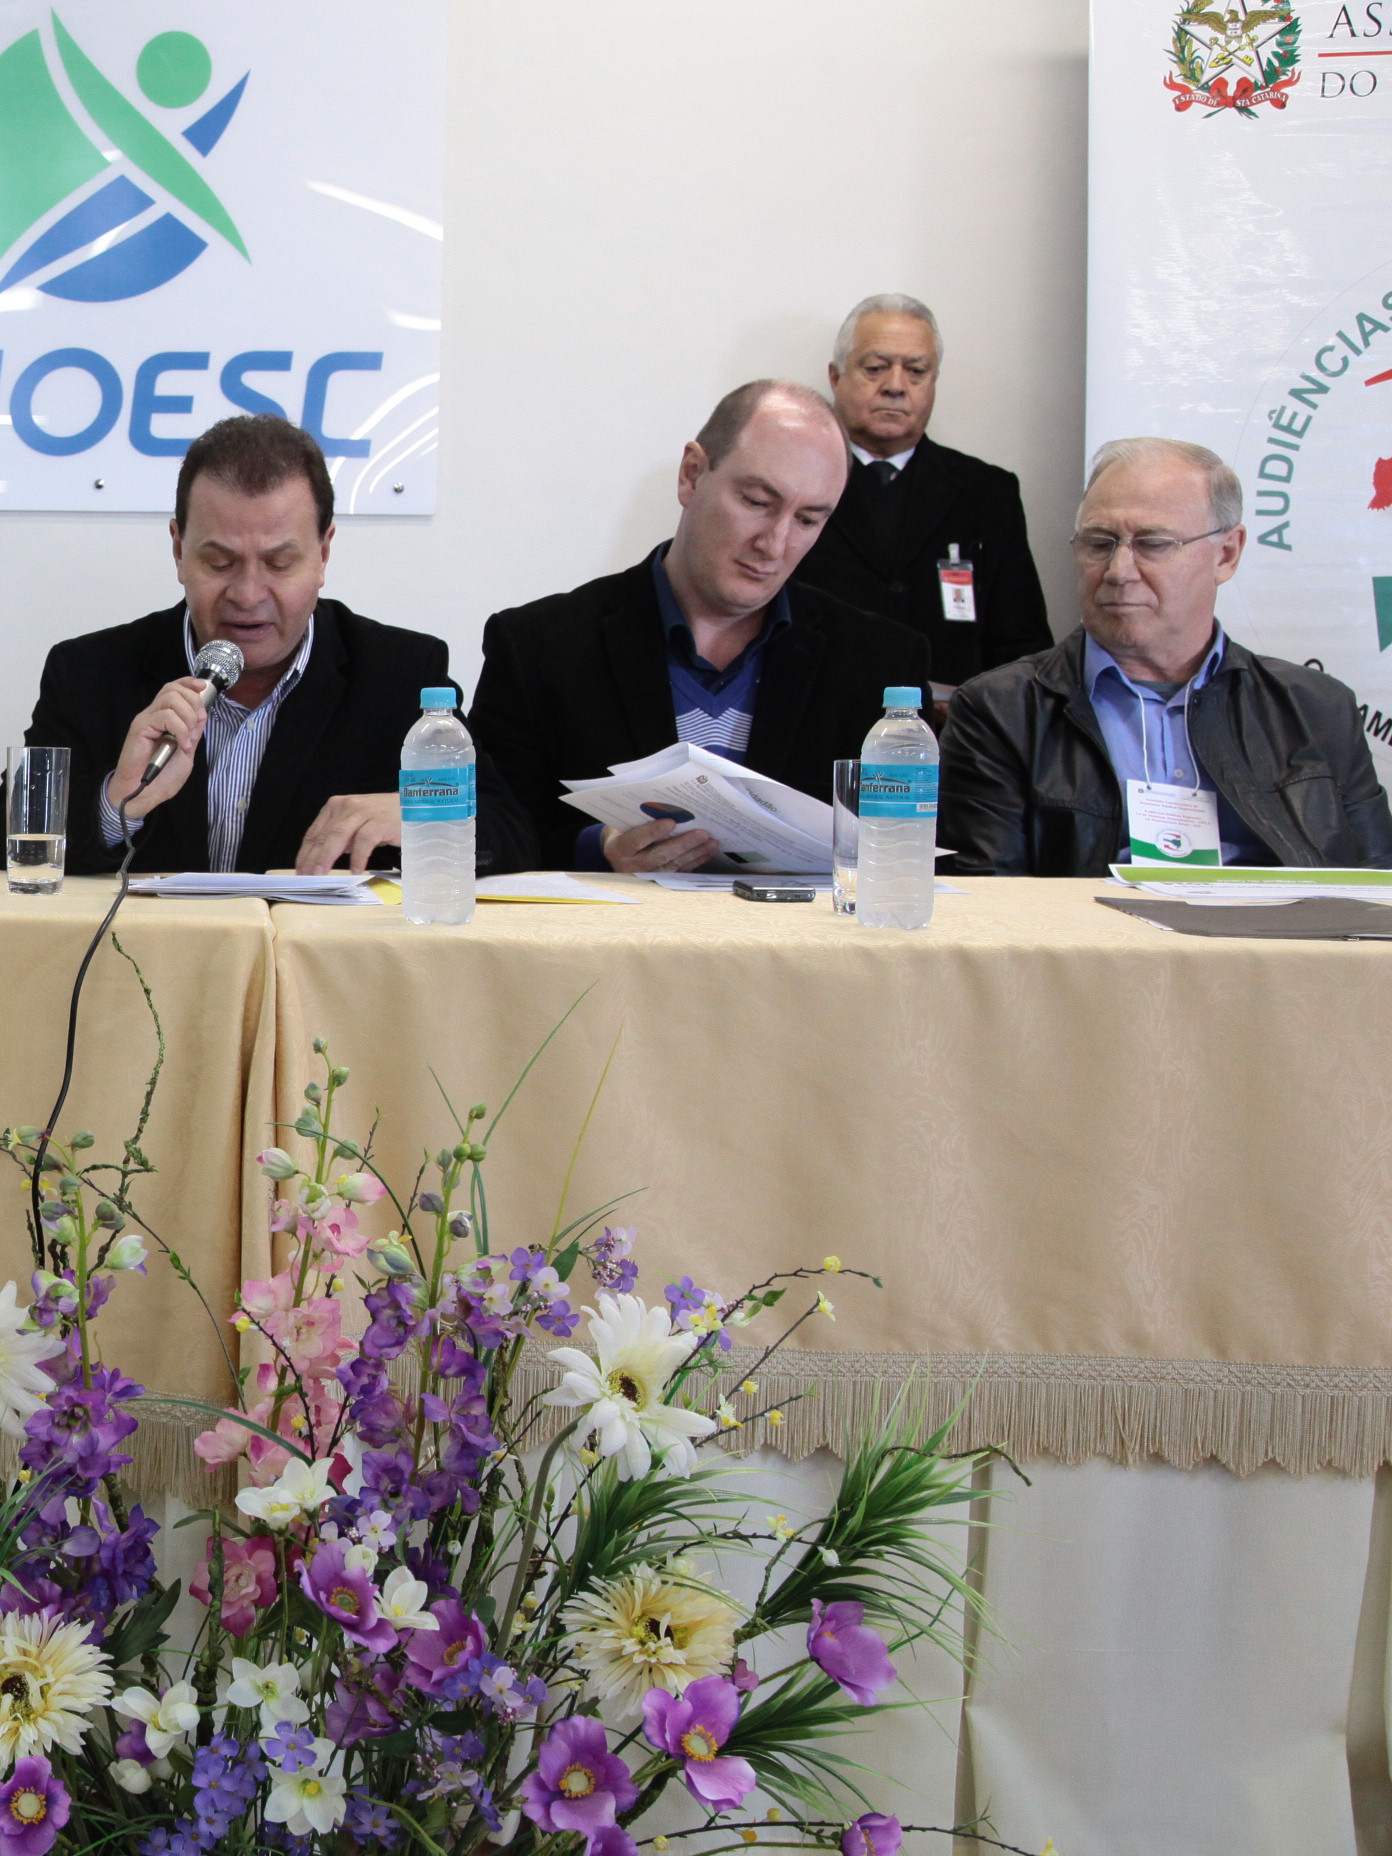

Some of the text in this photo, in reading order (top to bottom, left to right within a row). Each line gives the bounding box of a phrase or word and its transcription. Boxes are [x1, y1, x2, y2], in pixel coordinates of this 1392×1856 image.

[1324, 2, 1392, 39] AS
[1251, 91, 1287, 104] CATARINA
[1319, 70, 1377, 98] DO
